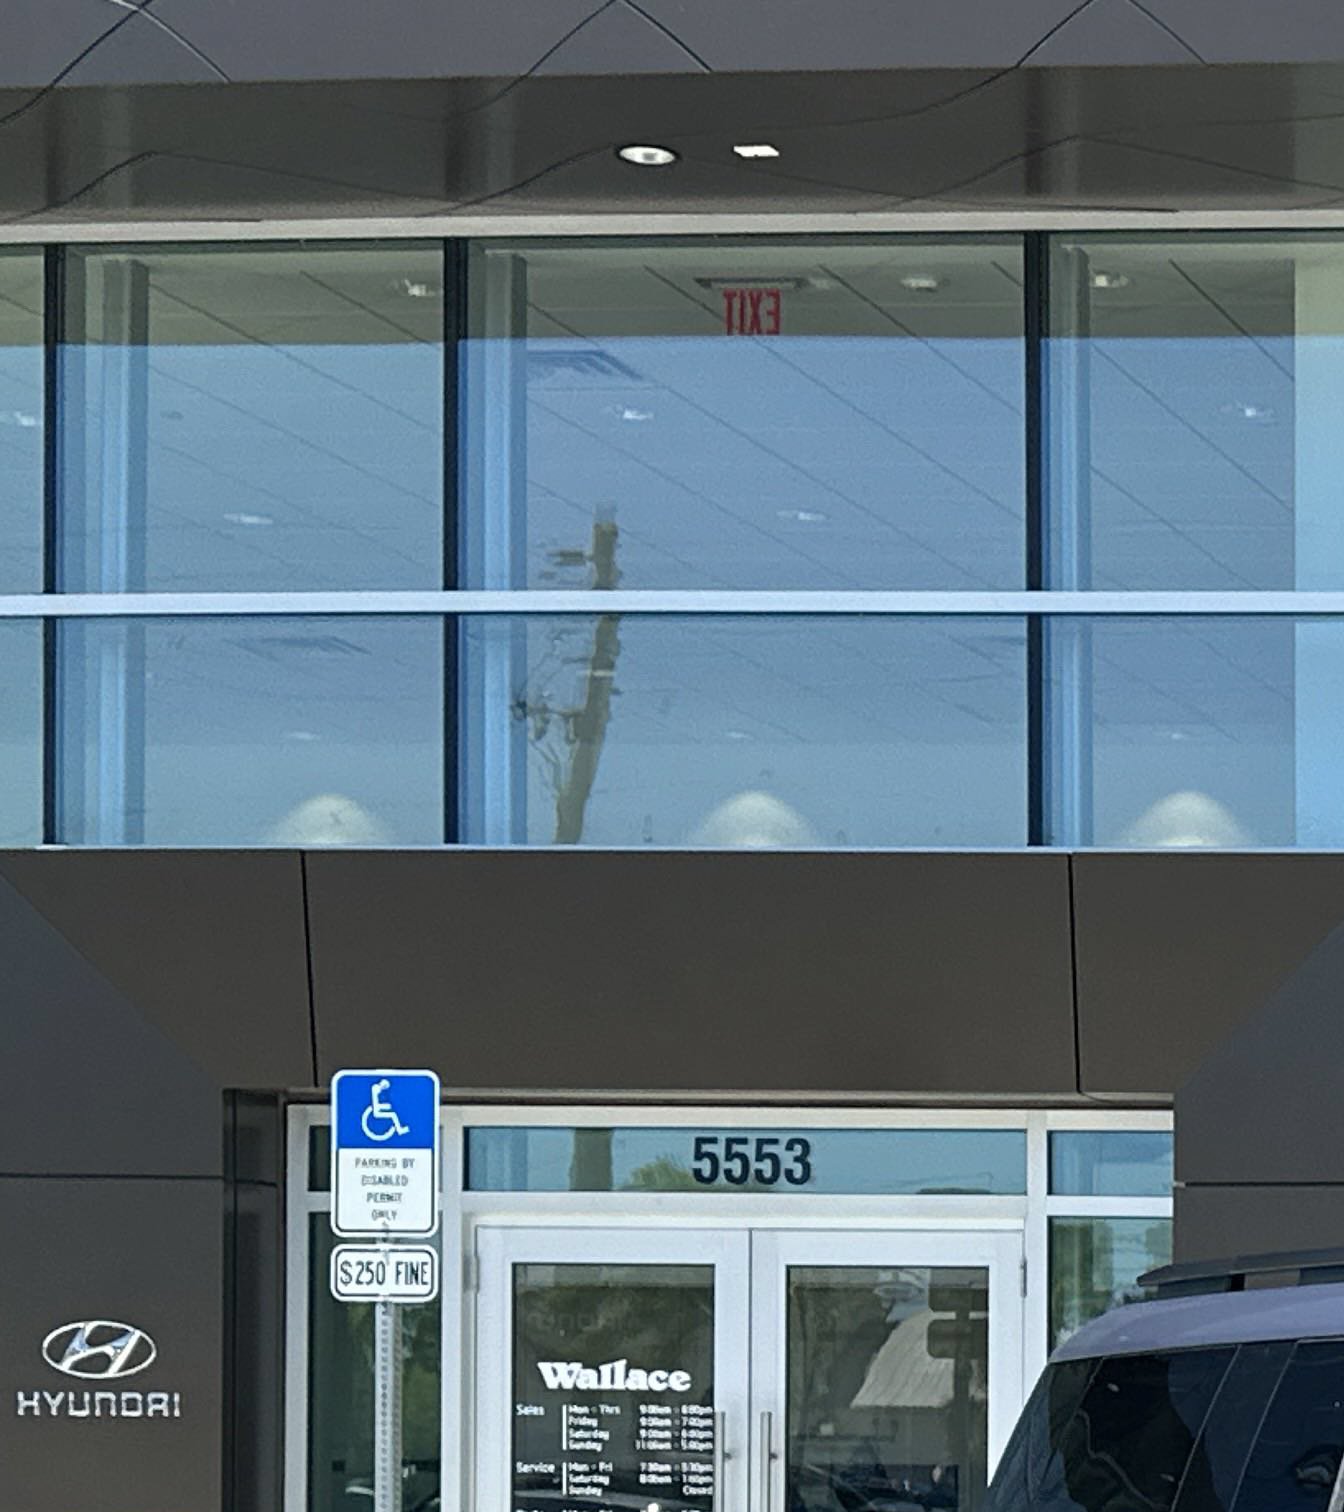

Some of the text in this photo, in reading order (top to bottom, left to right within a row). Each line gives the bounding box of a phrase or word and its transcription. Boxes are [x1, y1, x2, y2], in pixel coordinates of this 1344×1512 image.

[354, 1158, 415, 1168] PARKING BY
[692, 1137, 811, 1185] 5553
[361, 1175, 409, 1187] DISABLED
[366, 1192, 402, 1204] PERMIT
[340, 1260, 429, 1287] $250 FINE
[537, 1359, 692, 1391] Wallace
[17, 1391, 181, 1418] HYUNDAI
[516, 1404, 545, 1416] Sales
[568, 1404, 590, 1415] Mon
[568, 1416, 598, 1428] Friday
[568, 1428, 610, 1441] Saturday
[568, 1440, 602, 1452] Sunday
[516, 1461, 555, 1473] Service
[568, 1462, 590, 1472] Mon
[598, 1462, 613, 1472] Fri
[568, 1474, 610, 1486] Saturday
[568, 1485, 713, 1497] Sunday Closed
